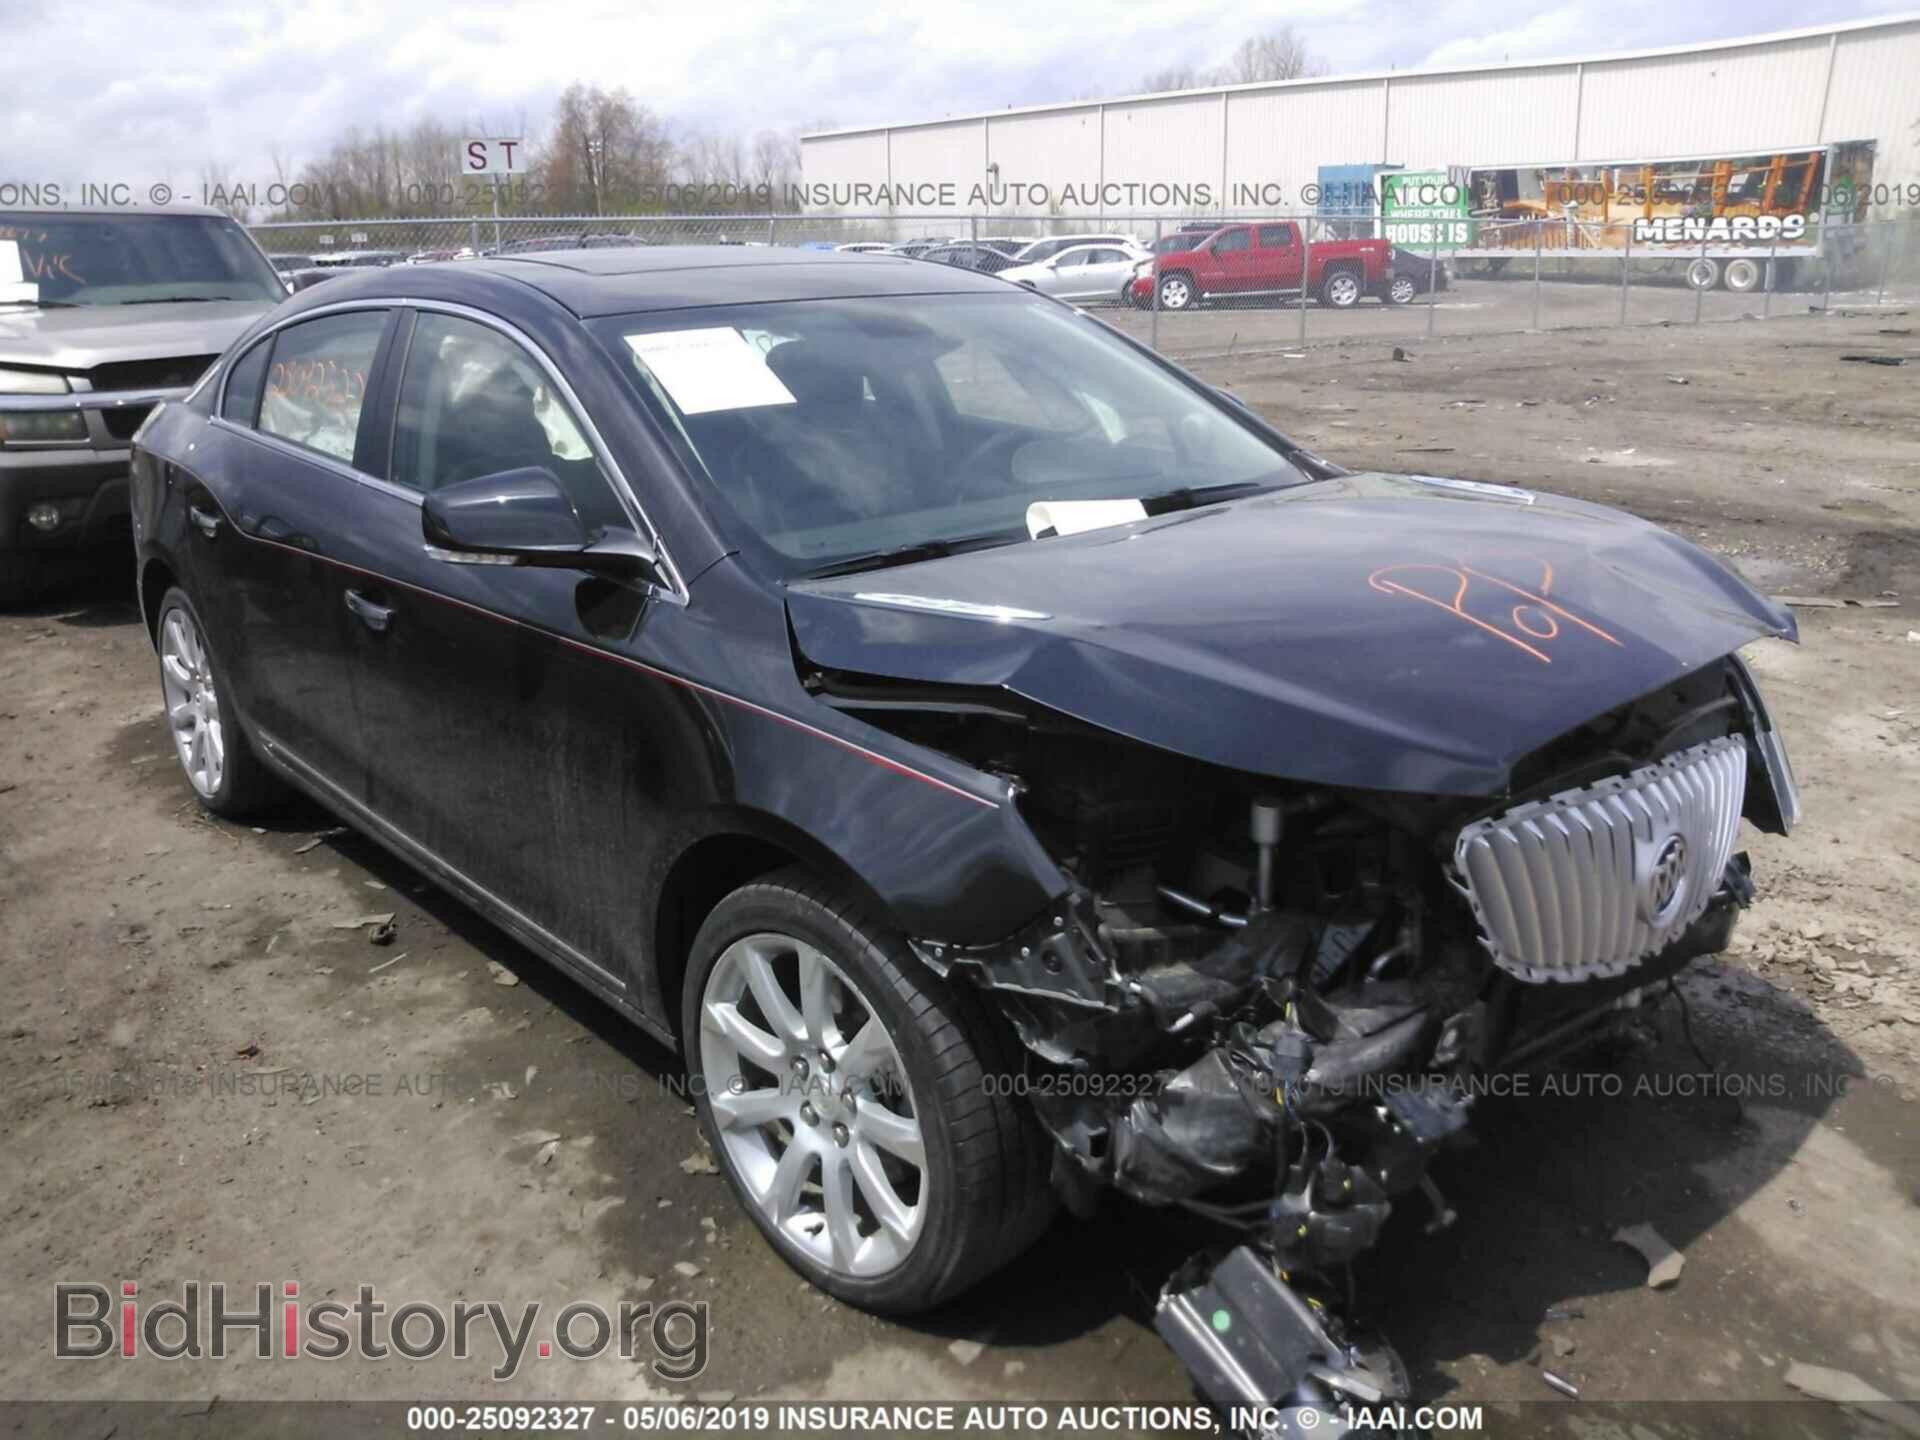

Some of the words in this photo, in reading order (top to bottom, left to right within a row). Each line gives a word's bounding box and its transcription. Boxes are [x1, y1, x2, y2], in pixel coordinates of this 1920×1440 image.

[1385, 223, 1443, 243] HOUSE
[1447, 222, 1467, 242] IS
[1635, 213, 1806, 241] MENARDS
